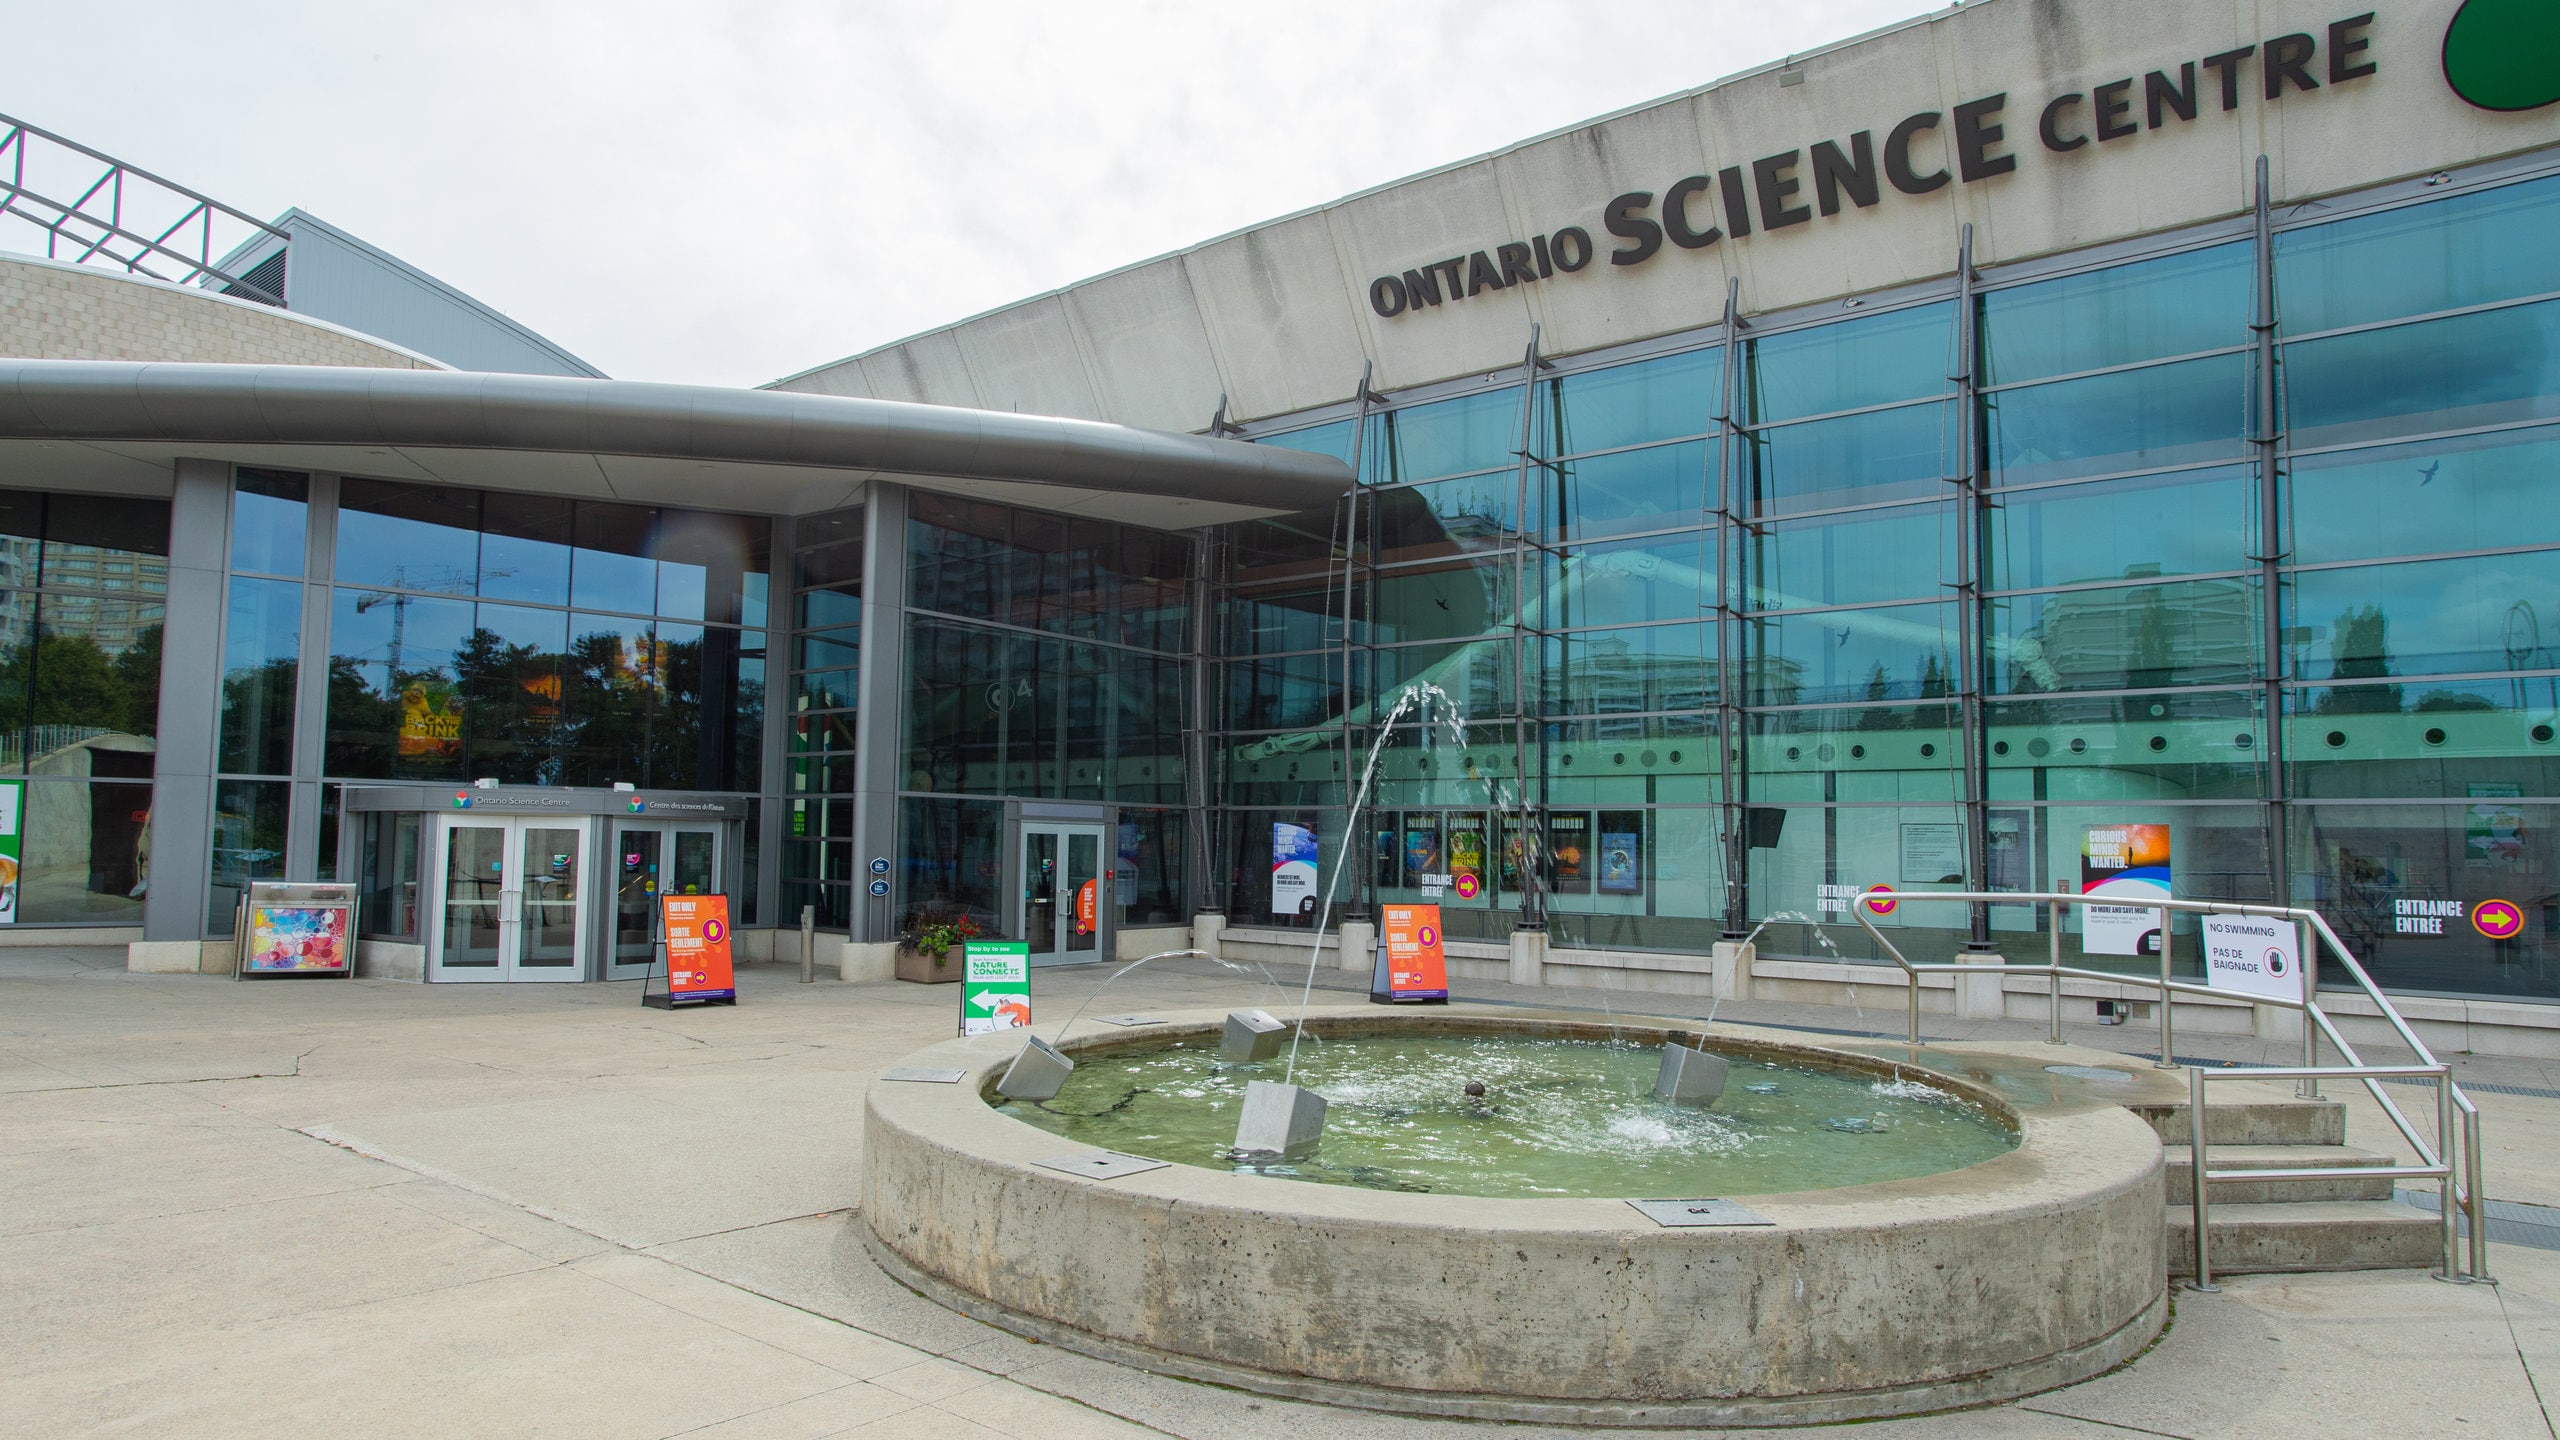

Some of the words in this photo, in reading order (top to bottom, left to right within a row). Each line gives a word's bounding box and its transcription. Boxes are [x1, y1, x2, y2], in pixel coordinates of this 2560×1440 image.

[1369, 225, 1593, 318] ONTARIO
[1604, 92, 2016, 265] SCIENCE
[2039, 11, 2377, 153] CENTRE
[475, 796, 507, 804] Ontario
[509, 797, 540, 805] Science
[541, 797, 571, 806] Centre
[649, 801, 669, 809] Centre
[2089, 830, 2127, 843] CURIOUS
[2089, 843, 2119, 855] MINDS
[2089, 855, 2128, 869] WANTED.
[1422, 873, 1453, 886] ENTRANCE
[1422, 885, 1443, 897] ENTRÉE
[1817, 885, 1860, 898] ENTRANCE
[669, 902, 681, 912] EXIT
[682, 902, 696, 912] ONLY
[1817, 897, 1847, 912] ENTRÉE
[2112, 906, 2122, 914] AND
[2134, 907, 2150, 915] MORE.
[2395, 899, 2463, 917] ENTRANCE
[2210, 923, 2223, 932] NO
[2224, 924, 2275, 937] SWIMMING
[2395, 916, 2443, 934] ENTRÉE
[670, 927, 690, 937] SORTIE
[671, 937, 703, 948] SEULEMENT
[2213, 947, 2230, 958] PAS
[2231, 949, 2243, 959] DE
[2213, 959, 2259, 973] BAIGNADE
